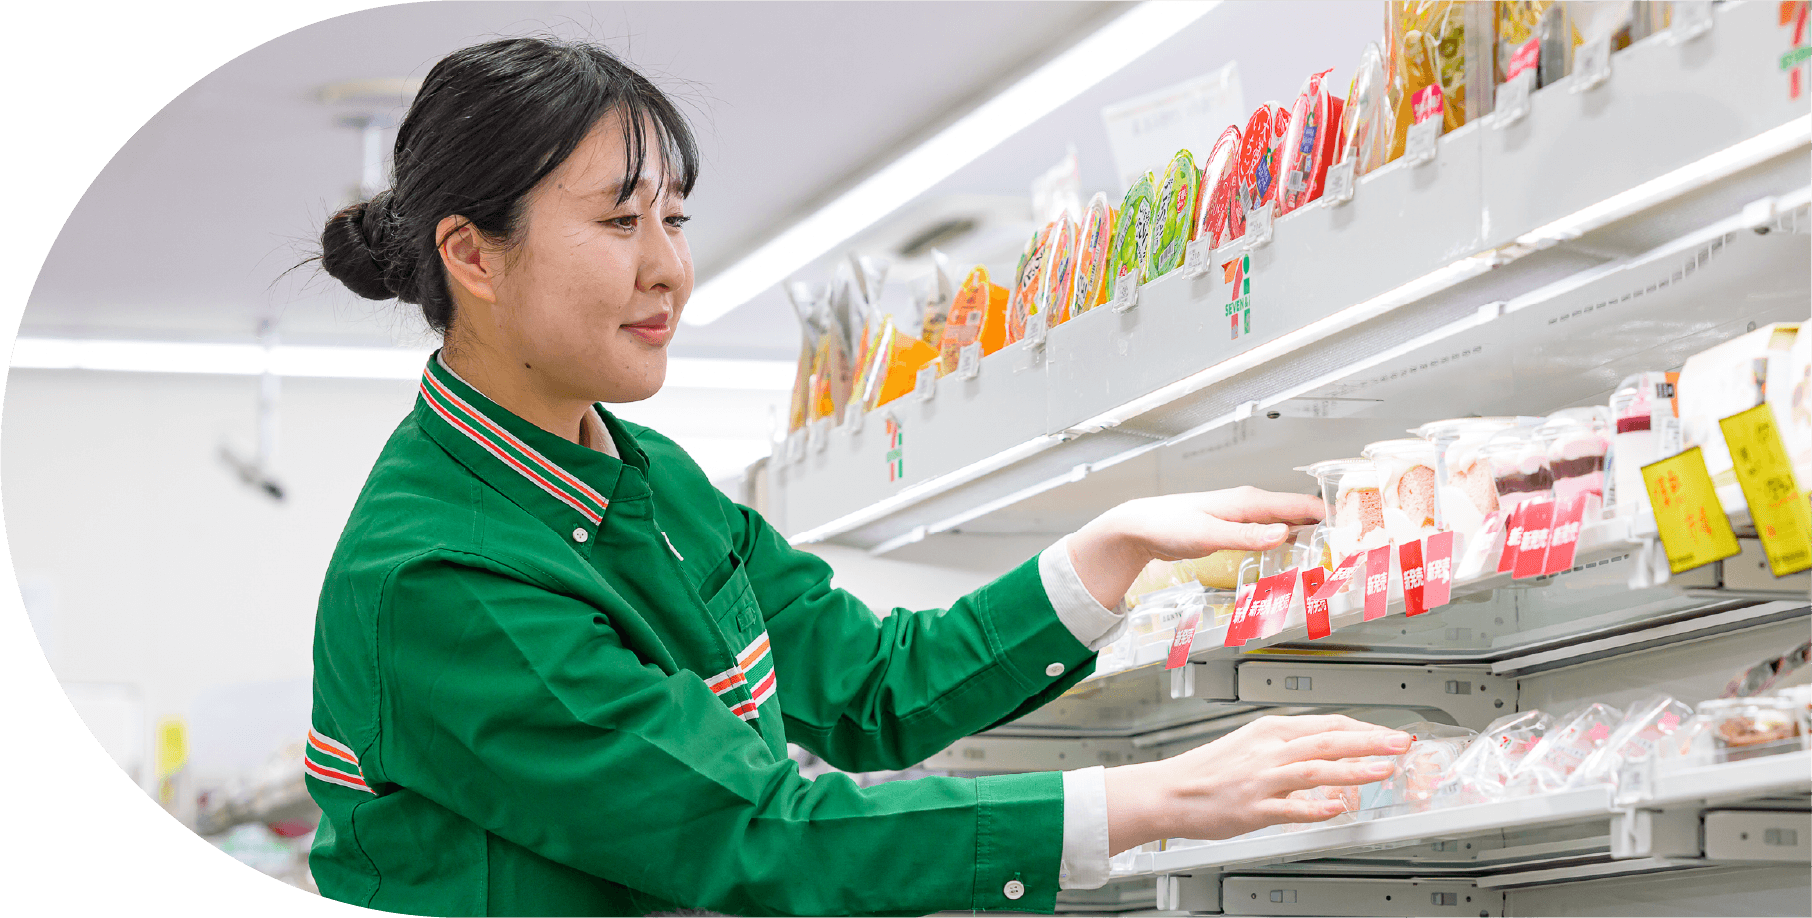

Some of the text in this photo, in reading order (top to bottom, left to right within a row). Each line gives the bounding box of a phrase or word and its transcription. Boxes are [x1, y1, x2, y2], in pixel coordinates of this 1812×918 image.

[1403, 566, 1424, 591] 新発売
[1427, 556, 1451, 584] 新発売
[1366, 571, 1388, 596] 新発売
[1174, 627, 1196, 647] 新発売
